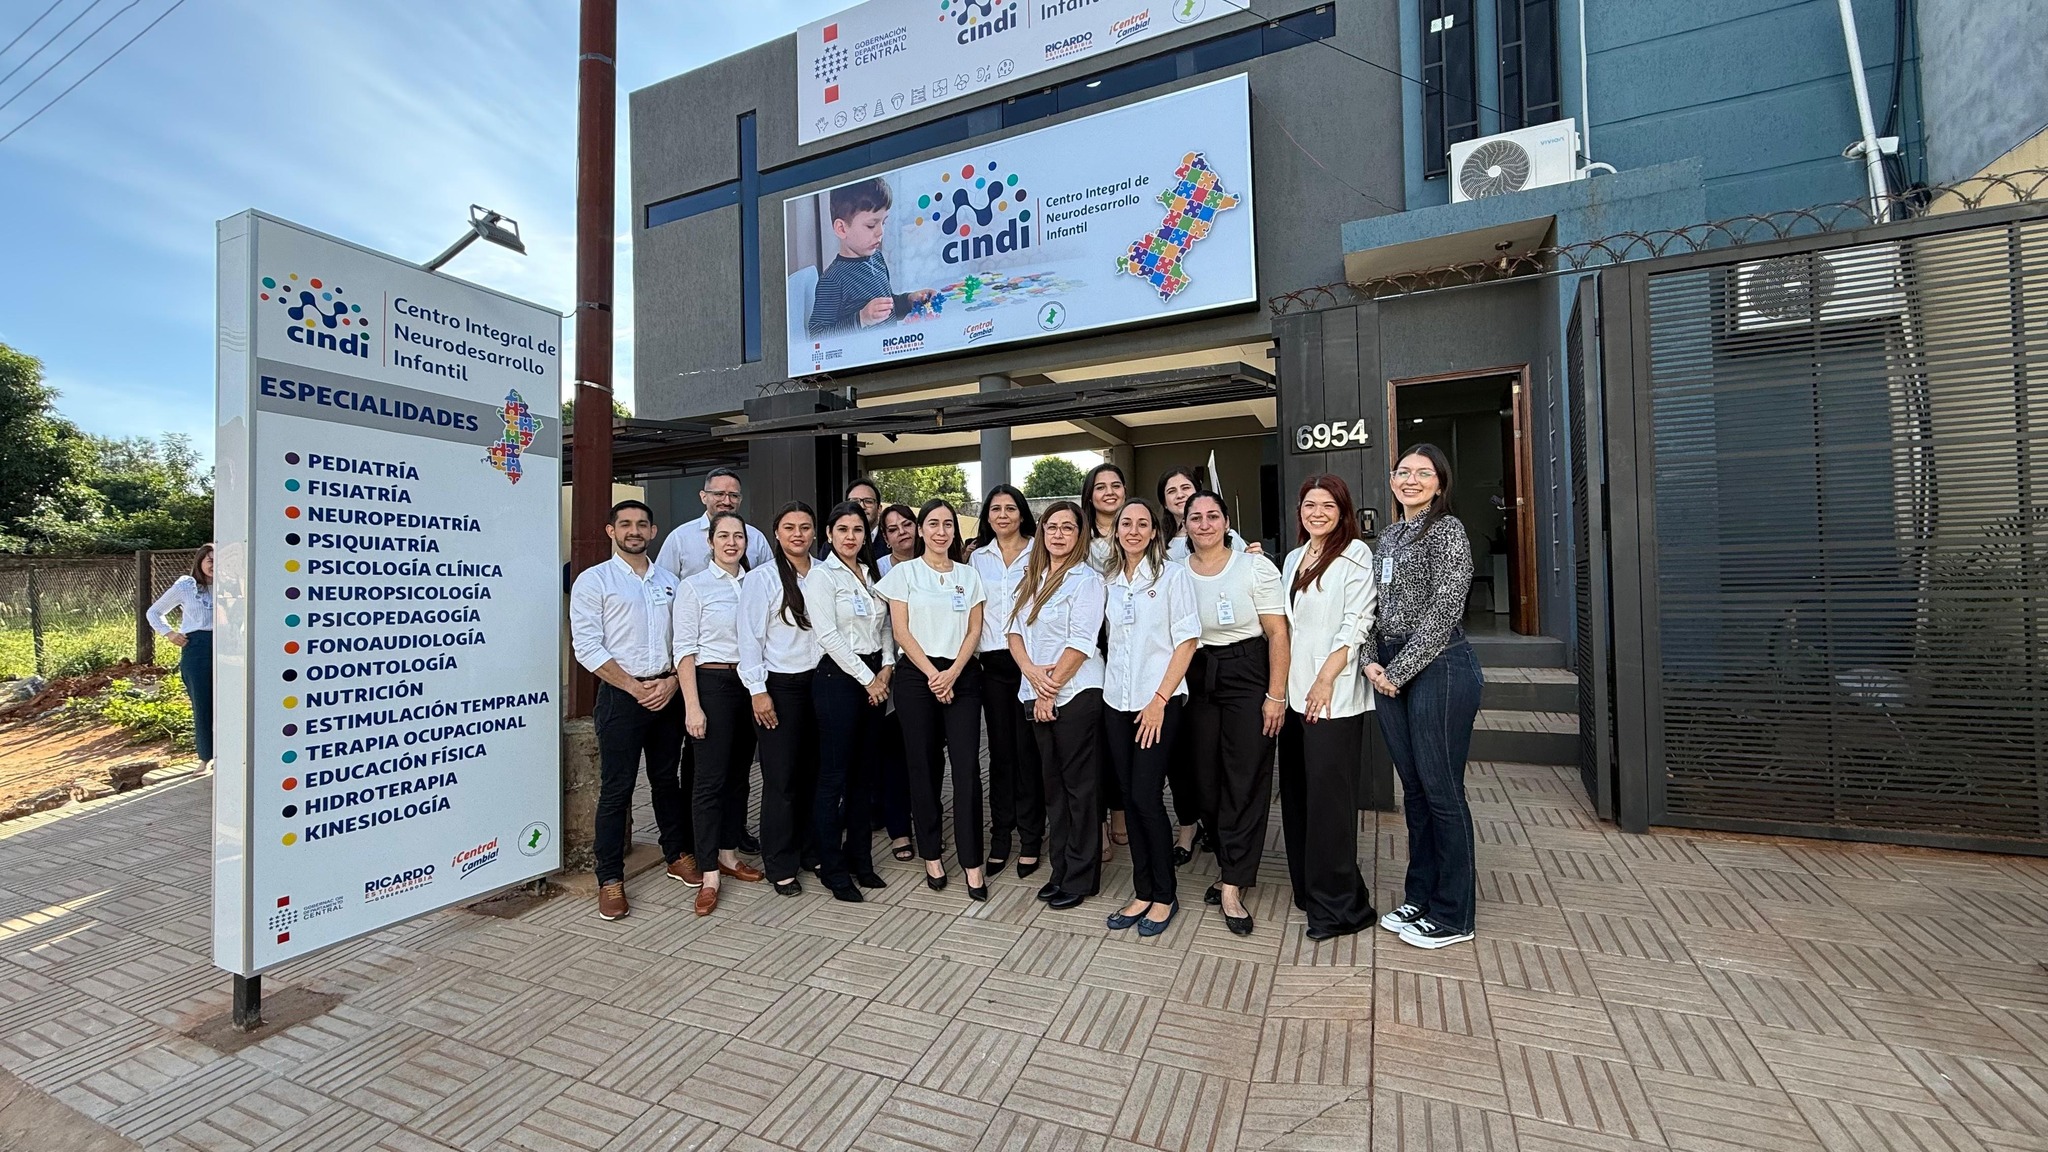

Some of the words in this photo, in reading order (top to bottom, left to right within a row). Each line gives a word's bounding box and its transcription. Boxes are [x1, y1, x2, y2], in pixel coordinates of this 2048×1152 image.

[1042, 0, 1099, 20] Infan
[1109, 8, 1149, 35] ¡Central
[855, 26, 907, 49] GOBERNACIÓN
[957, 7, 1017, 45] cindi
[1117, 17, 1151, 39] Cambia!
[855, 34, 907, 58] DEPARTAMENTO
[855, 43, 907, 66] CENTRAL
[1045, 31, 1093, 53] RICARDO
[1046, 191, 1083, 208] Centro
[1086, 178, 1131, 200] Integral
[1135, 175, 1149, 187] de
[1047, 195, 1140, 224] Neurodesarrollo
[942, 214, 1030, 264] cindi
[1047, 222, 1088, 241] Infantil
[287, 322, 369, 358] cindi
[394, 298, 460, 329] Centro
[466, 318, 534, 350] Integral
[537, 339, 556, 356] de
[883, 333, 924, 348] RICARDO
[394, 323, 544, 375] Neurodesarrollo
[394, 350, 468, 381] Infantil
[260, 376, 478, 431] ESPECIALIDADES
[1296, 418, 1369, 450] 6954
[308, 453, 420, 480] PEDIATRÍA
[308, 480, 412, 503] FISIATRÍA
[308, 506, 481, 532] NEUROPEDIATRÍA
[308, 533, 440, 553] PSIQUIATRÍA
[308, 558, 431, 576] PSICOLOGÍA
[435, 560, 503, 577] CLÍNICA
[307, 583, 492, 600] NEUROPSICOLOGÍA
[307, 605, 481, 627] PSICOPEDAGOGÍA
[307, 629, 486, 654] FONOAUDIOLOGÍA
[306, 653, 458, 681] ODONTOLOGÍA
[306, 680, 423, 708] NUTRICIÓN
[306, 700, 457, 734] ESTIMULACIÓN
[461, 691, 549, 713] TEMPRANA
[306, 734, 399, 761] TERAPIA
[403, 715, 526, 745] OCUPACIONAL
[305, 752, 427, 788] EDUCACIÓN
[431, 744, 487, 765] FÍSICA
[305, 772, 458, 815] HIDROTERAPIA
[305, 795, 451, 842] KINESIOLOGÍA
[451, 837, 498, 868] ¡Central
[462, 848, 499, 872] Cambia!
[365, 865, 435, 893] RICARDO
[303, 905, 344, 920] CENTRAL
